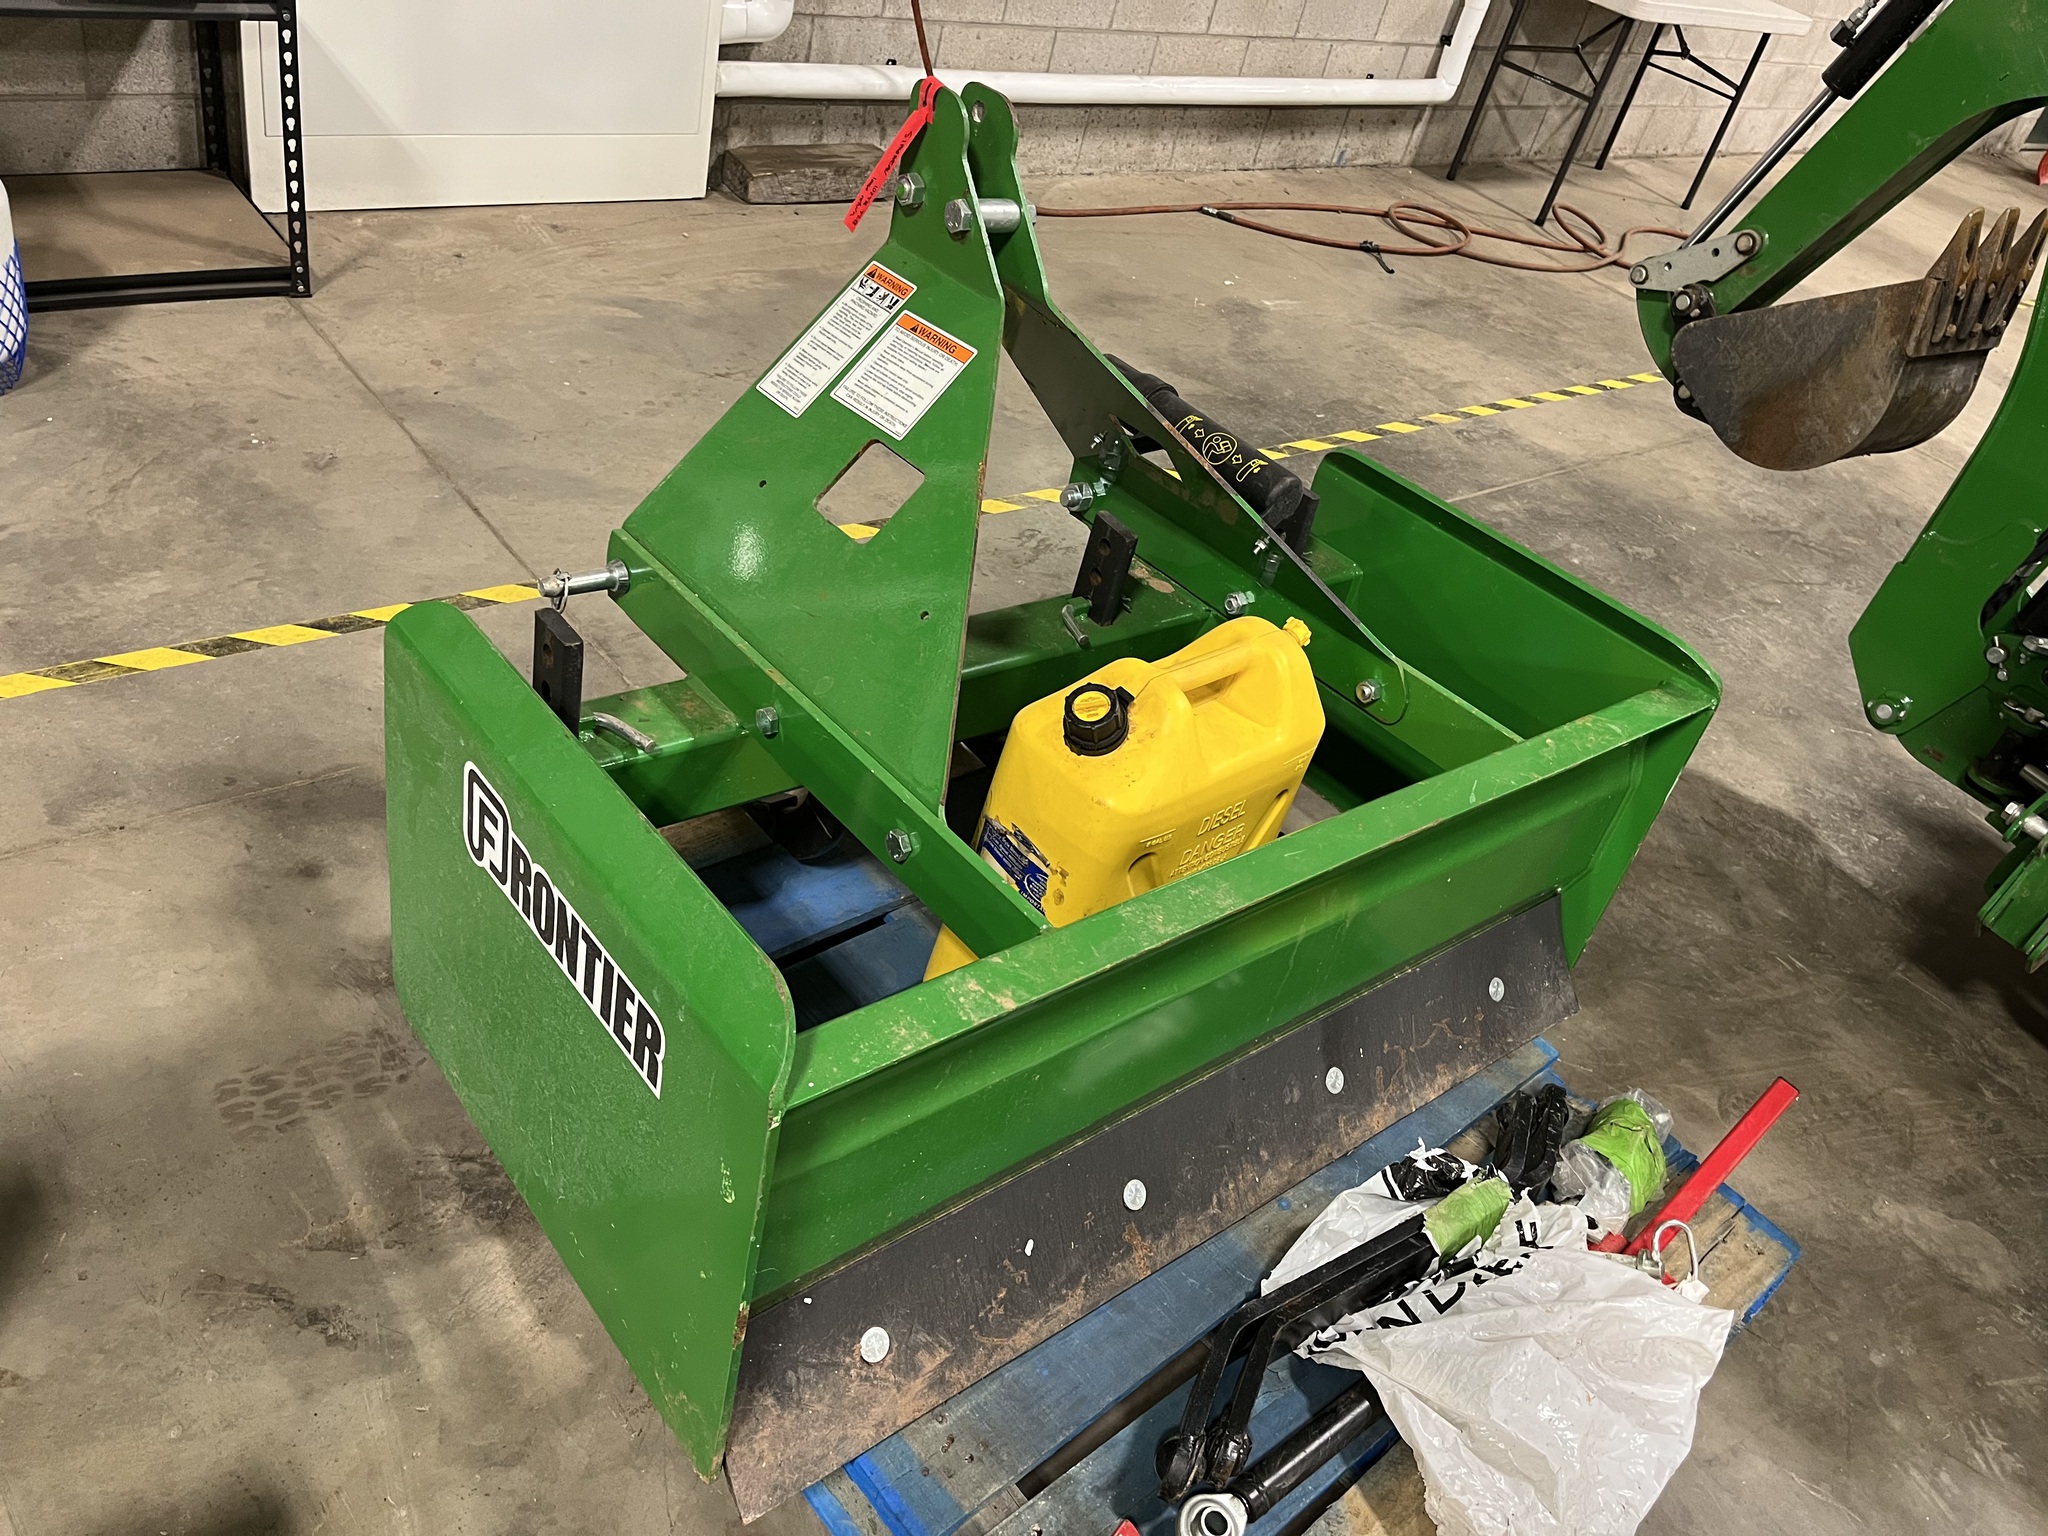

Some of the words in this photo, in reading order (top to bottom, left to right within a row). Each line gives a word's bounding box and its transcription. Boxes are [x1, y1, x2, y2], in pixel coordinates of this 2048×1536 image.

[873, 271, 909, 296] WARNING
[916, 326, 958, 354] WARNING
[1197, 799, 1247, 836] DIESEL
[1179, 823, 1245, 866] DANGER
[1020, 890, 1046, 913] IMPORTA
[467, 768, 663, 1088] FRONTIER
